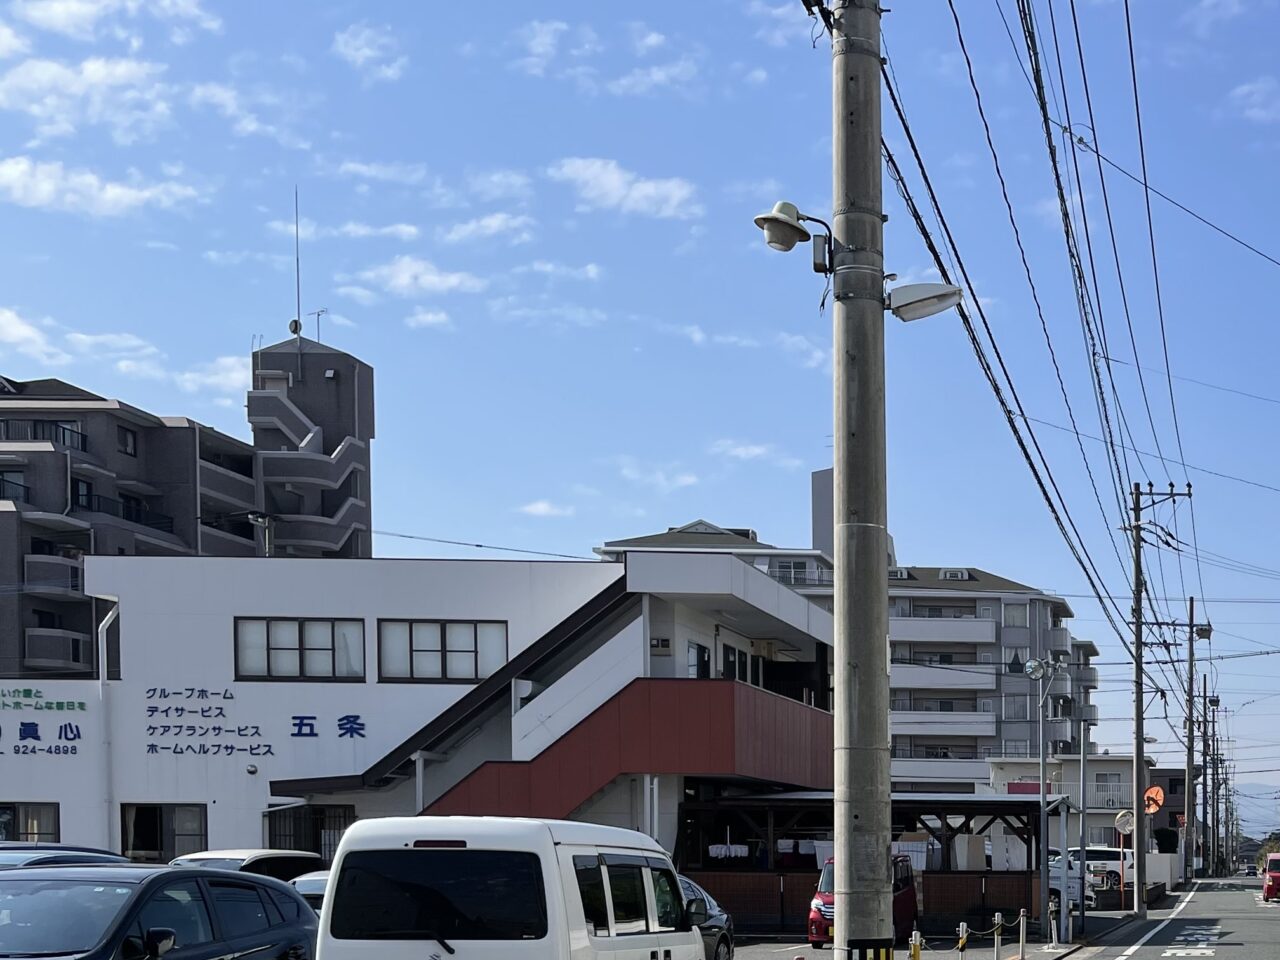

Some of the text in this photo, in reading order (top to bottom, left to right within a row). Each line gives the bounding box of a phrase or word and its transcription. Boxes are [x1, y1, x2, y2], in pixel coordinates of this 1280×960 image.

[145, 687, 235, 701] グループホーム
[145, 705, 227, 719] デイサービス
[146, 724, 263, 738] ケアプランサービス
[289, 714, 367, 739] 五条
[13, 744, 78, 755] 924-4898
[146, 742, 276, 757] ホームヘルプサービス
